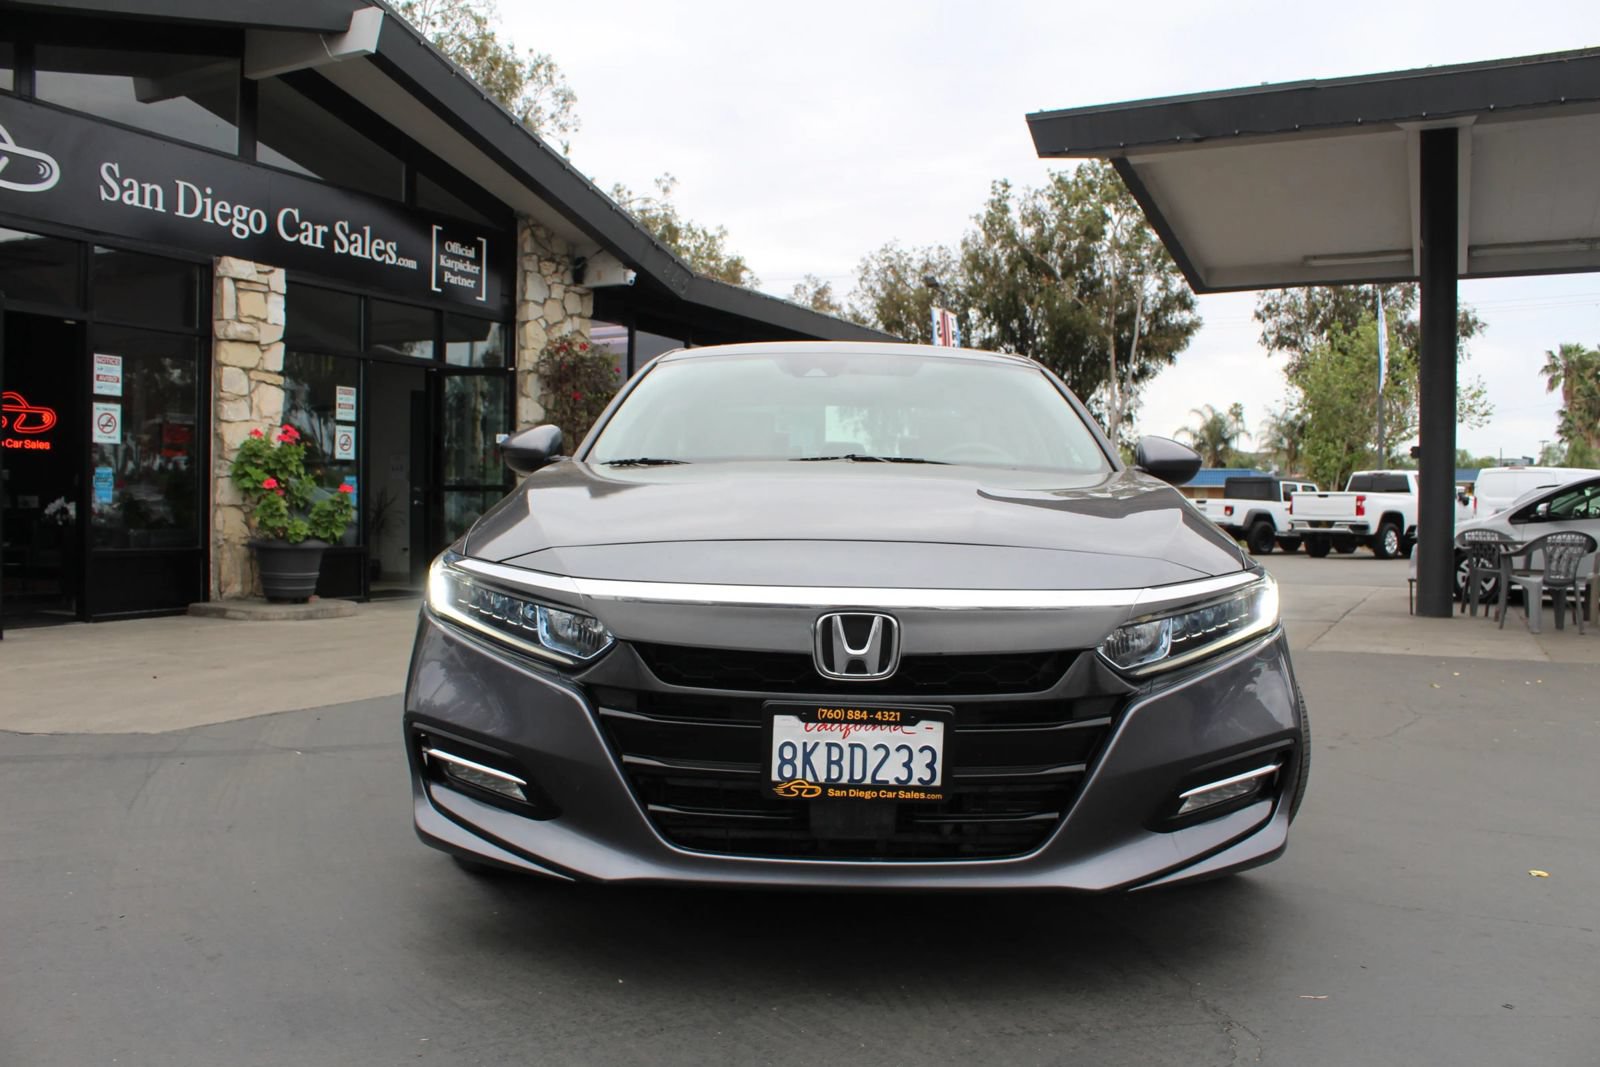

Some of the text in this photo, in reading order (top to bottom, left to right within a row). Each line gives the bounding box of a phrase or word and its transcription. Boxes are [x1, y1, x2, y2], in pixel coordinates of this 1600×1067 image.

[99, 162, 166, 212] San
[174, 179, 267, 239] Diego
[277, 208, 328, 248] Car
[445, 241, 475, 258] Official
[440, 255, 480, 274] Karpicker
[444, 271, 475, 288] Partner
[5, 438, 23, 448] Car
[24, 439, 51, 450] Sales
[817, 708, 845, 721] (760)
[777, 741, 937, 786] 8KBD233
[827, 788, 847, 798] San
[849, 789, 877, 800] Diego
[879, 790, 897, 799] Car
